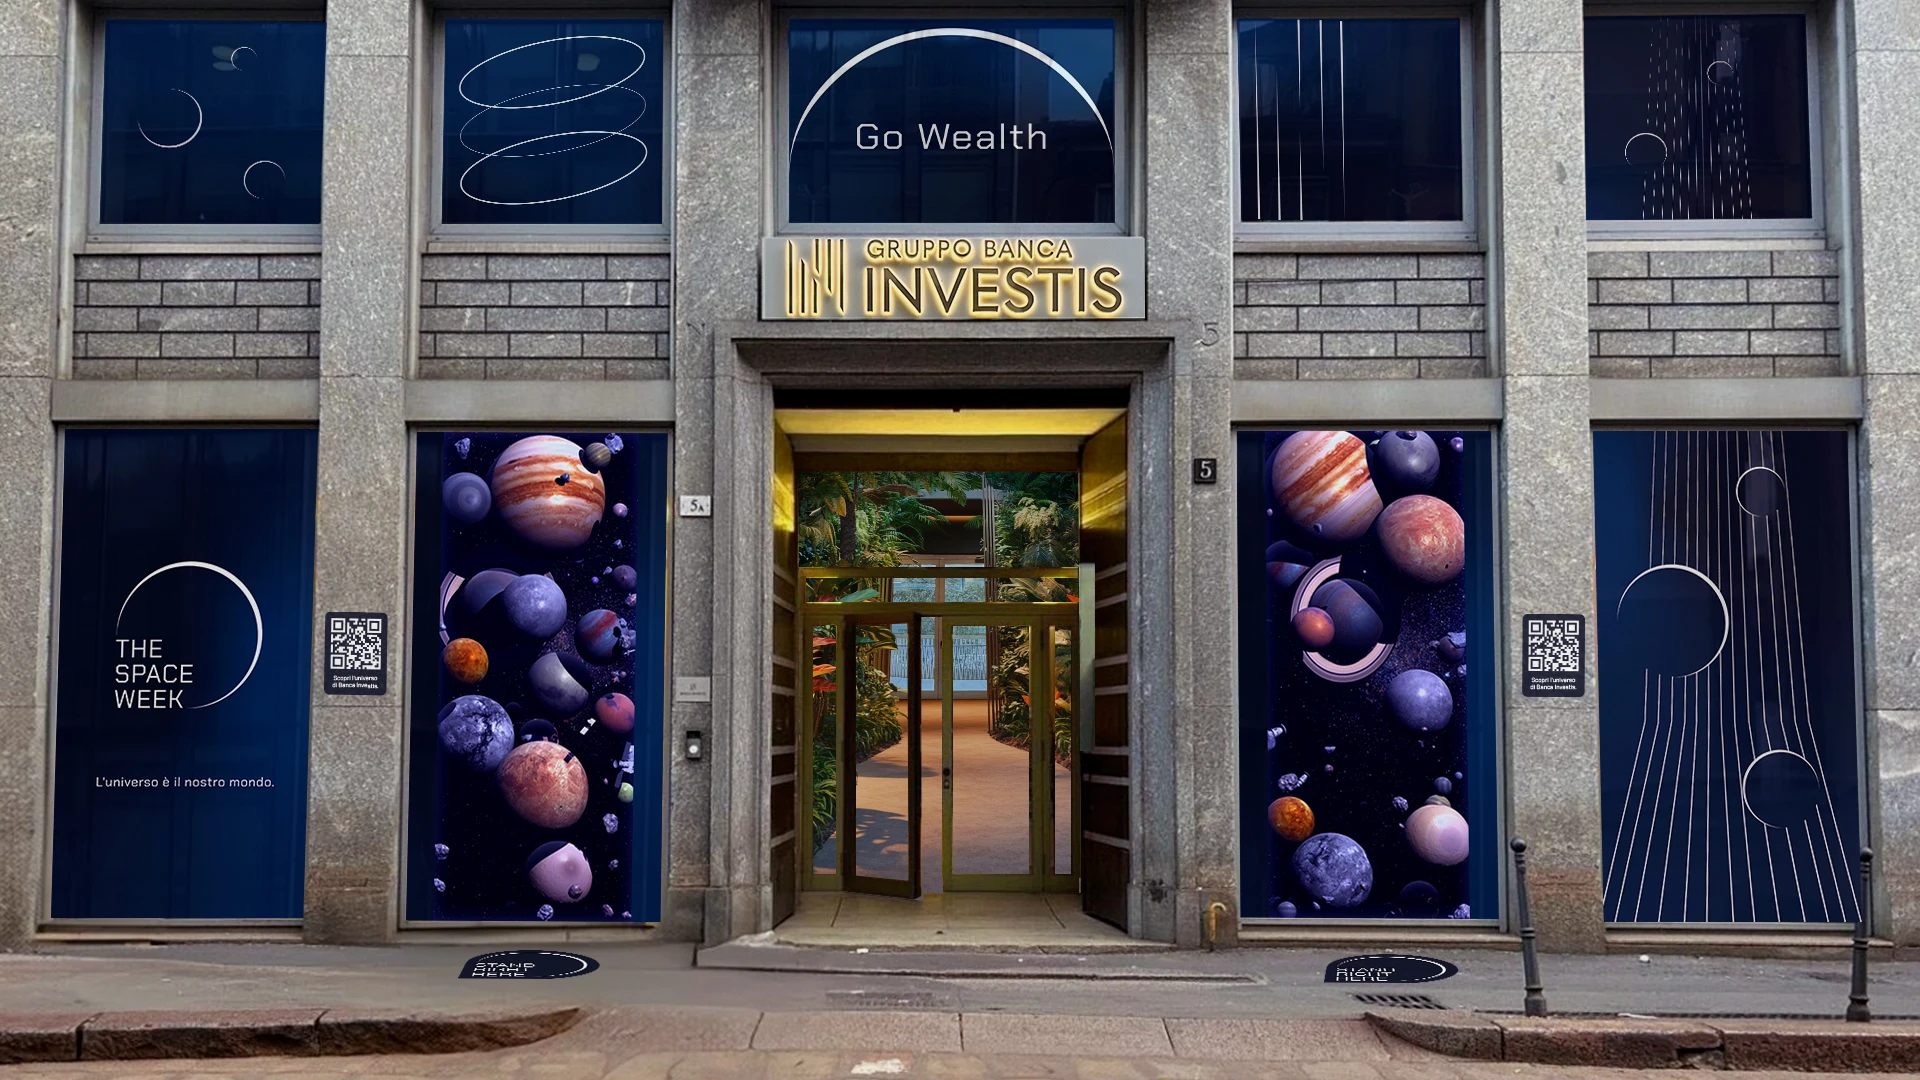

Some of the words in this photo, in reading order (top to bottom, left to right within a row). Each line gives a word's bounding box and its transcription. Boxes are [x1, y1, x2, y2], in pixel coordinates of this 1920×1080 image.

[856, 123, 903, 150] Go
[918, 123, 1047, 150] Wealth
[867, 239, 972, 259] GRUPPO
[984, 240, 1073, 259] BANCA
[866, 267, 1123, 313] INVESTIS
[1200, 322, 1219, 347] 5
[1200, 460, 1212, 479] 5
[115, 639, 163, 659] THE
[115, 664, 194, 684] SPACE
[114, 689, 184, 709] WEEK
[95, 777, 159, 788] L'universo
[162, 777, 170, 788] è
[174, 777, 181, 788] il
[184, 778, 226, 788] nostro
[229, 777, 276, 788] mondo.
